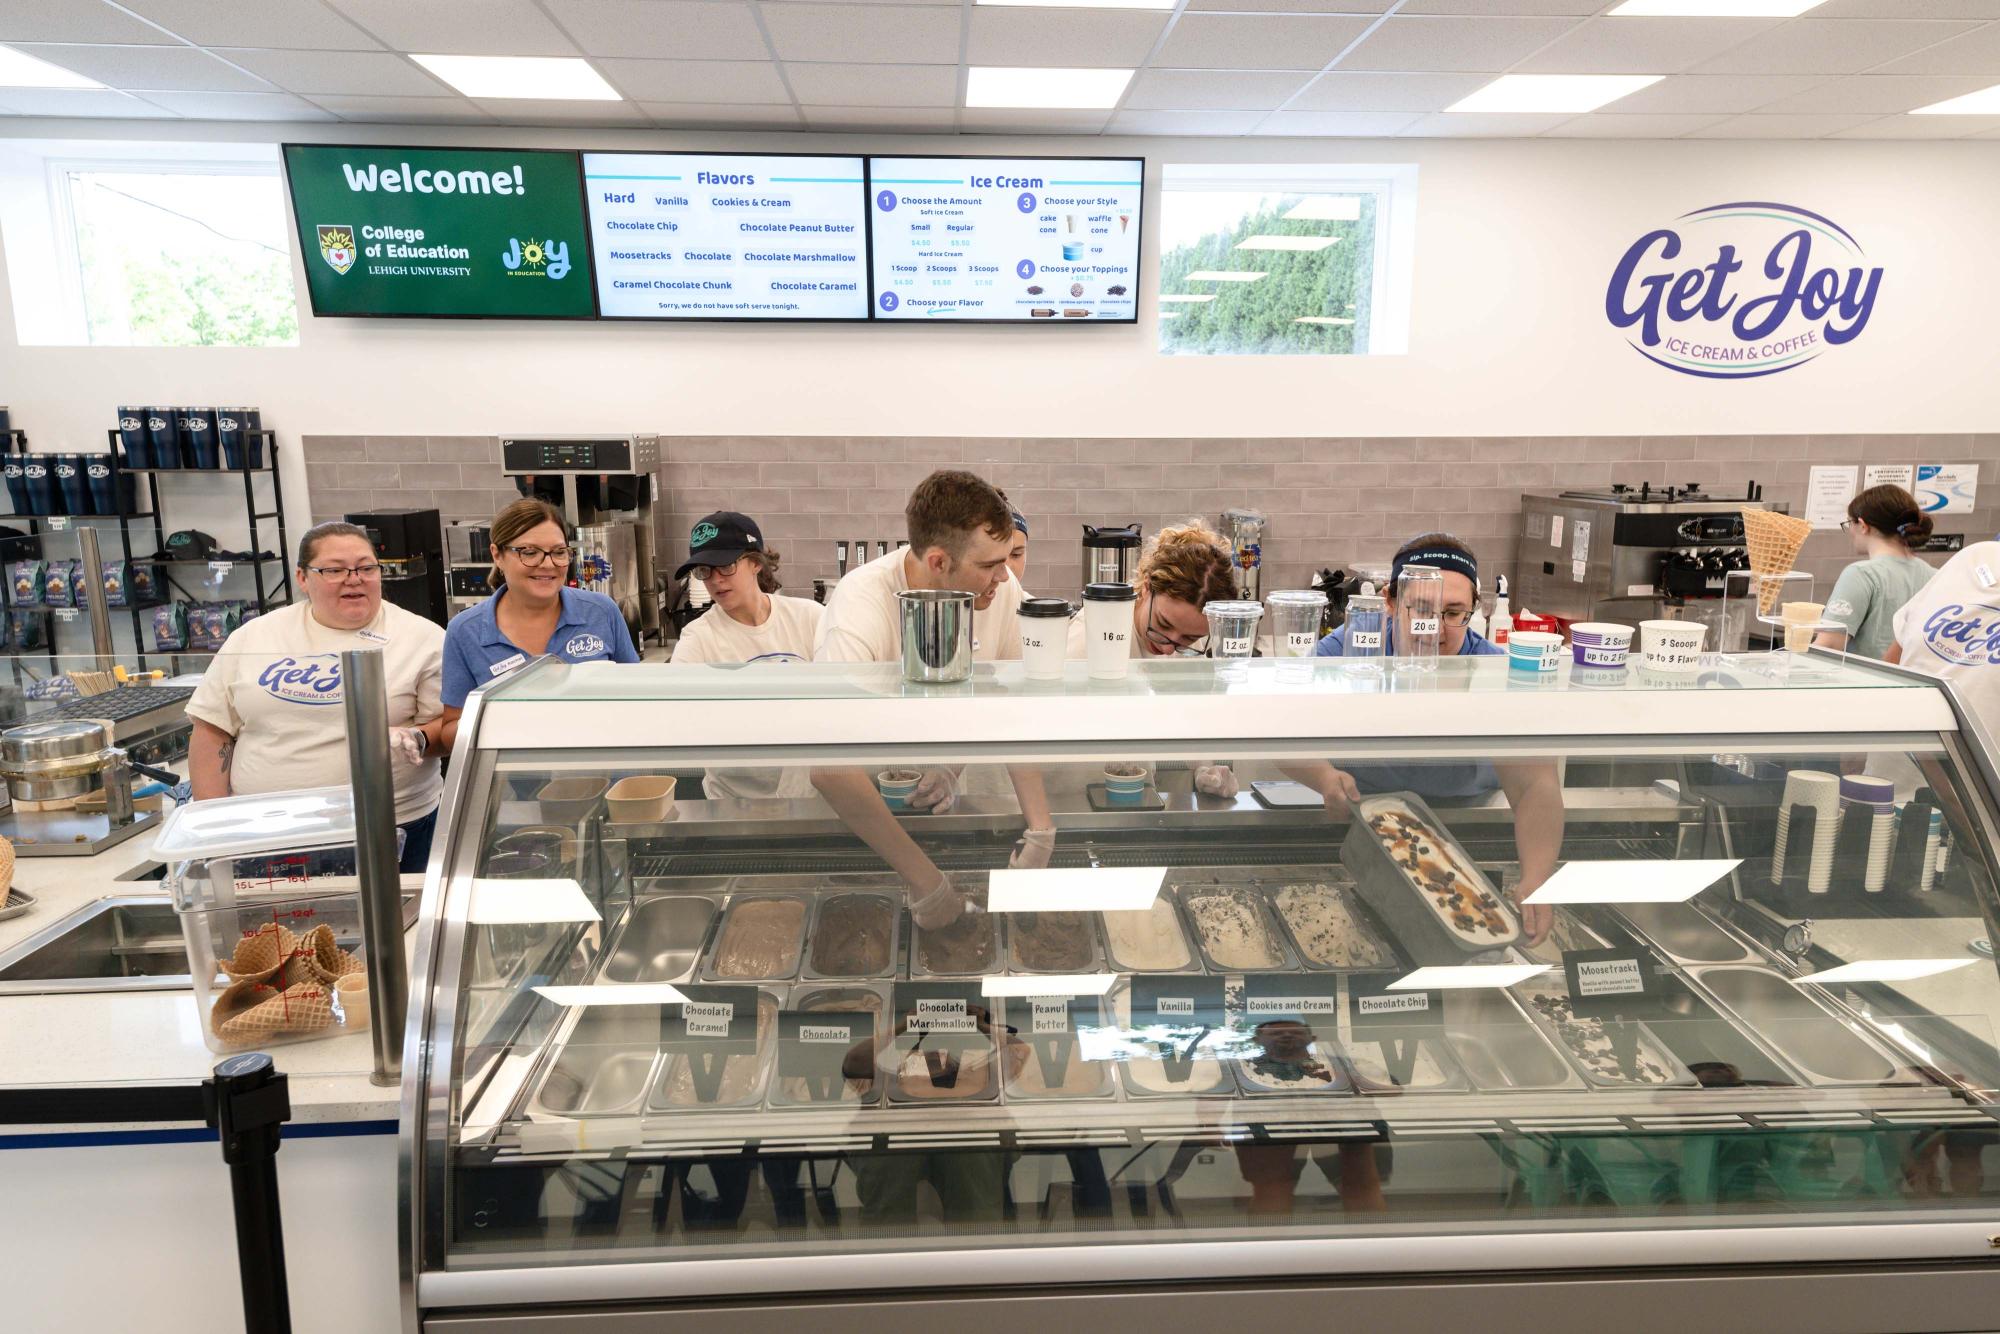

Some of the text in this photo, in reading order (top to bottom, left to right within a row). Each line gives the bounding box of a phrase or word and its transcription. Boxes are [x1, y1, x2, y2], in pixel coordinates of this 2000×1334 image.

[342, 163, 525, 196] Welcome!
[698, 172, 755, 185] Flavors
[970, 176, 1043, 188] Ice Cream
[604, 193, 636, 204] Hard
[656, 197, 689, 207] Vanilla
[712, 198, 791, 208] Cookies & Cream
[884, 196, 890, 206] 1
[901, 197, 932, 205] Choose
[934, 197, 947, 205] the
[1024, 197, 1118, 208] 3 Choose your Style
[1040, 214, 1057, 222] cake
[1088, 214, 1112, 222] waffle
[607, 221, 678, 232] Chocolate Chip
[740, 223, 855, 233] Chocolate Peanut Butter
[947, 224, 974, 233] Regular
[362, 225, 425, 242] College
[365, 244, 470, 259] of Education
[611, 251, 672, 260] Moosetracks
[684, 252, 732, 261] Chocolate
[744, 253, 856, 262] Chocolate Marshmallow
[369, 266, 471, 277] LEHIGH UNIVERSITY
[897, 265, 917, 273] Scoop
[1022, 265, 1030, 274] 4
[1040, 265, 1069, 273] Choose
[1092, 265, 1128, 274] Toppings
[613, 281, 732, 290] Caramel Chocolate Chunk
[771, 282, 857, 291] Chocolate Caramel
[1606, 229, 1884, 347] Get Joy
[659, 302, 680, 310] Sorry,
[771, 303, 800, 311] tonight.
[886, 297, 892, 307] 2
[907, 299, 936, 307] Choose
[959, 299, 983, 307] Flavor
[1666, 330, 1818, 361] ICE CREAM & COFFEE
[1414, 622, 1426, 631] 20
[1924, 605, 1981, 642] Get
[1103, 632, 1114, 641] 16
[1291, 636, 1301, 644] 16
[1356, 635, 1366, 644] 12
[566, 636, 604, 656] Get Joy
[1226, 641, 1237, 649] 12
[1604, 638, 1611, 646] 2
[1661, 638, 1697, 648] 3 Scoops
[1587, 653, 1596, 661] up
[1600, 652, 1609, 661] to
[1646, 653, 1675, 663] up to 3
[258, 658, 321, 692] Get
[293, 691, 318, 699] CREAM
[1581, 963, 1637, 975] Moosetracks
[919, 1003, 964, 1013] Chocolate
[1035, 1004, 1065, 1013] Peanut
[1160, 1001, 1192, 1012] Vanilla
[1249, 1000, 1332, 1010] Cookies and Cream
[1362, 997, 1427, 1010] Chocolate Chip
[685, 1006, 731, 1017] Chocolate
[690, 1022, 727, 1033] Caramel
[910, 1019, 975, 1029] Marshmallow
[1036, 1020, 1065, 1030] Butter
[803, 1029, 848, 1039] Chocolate
